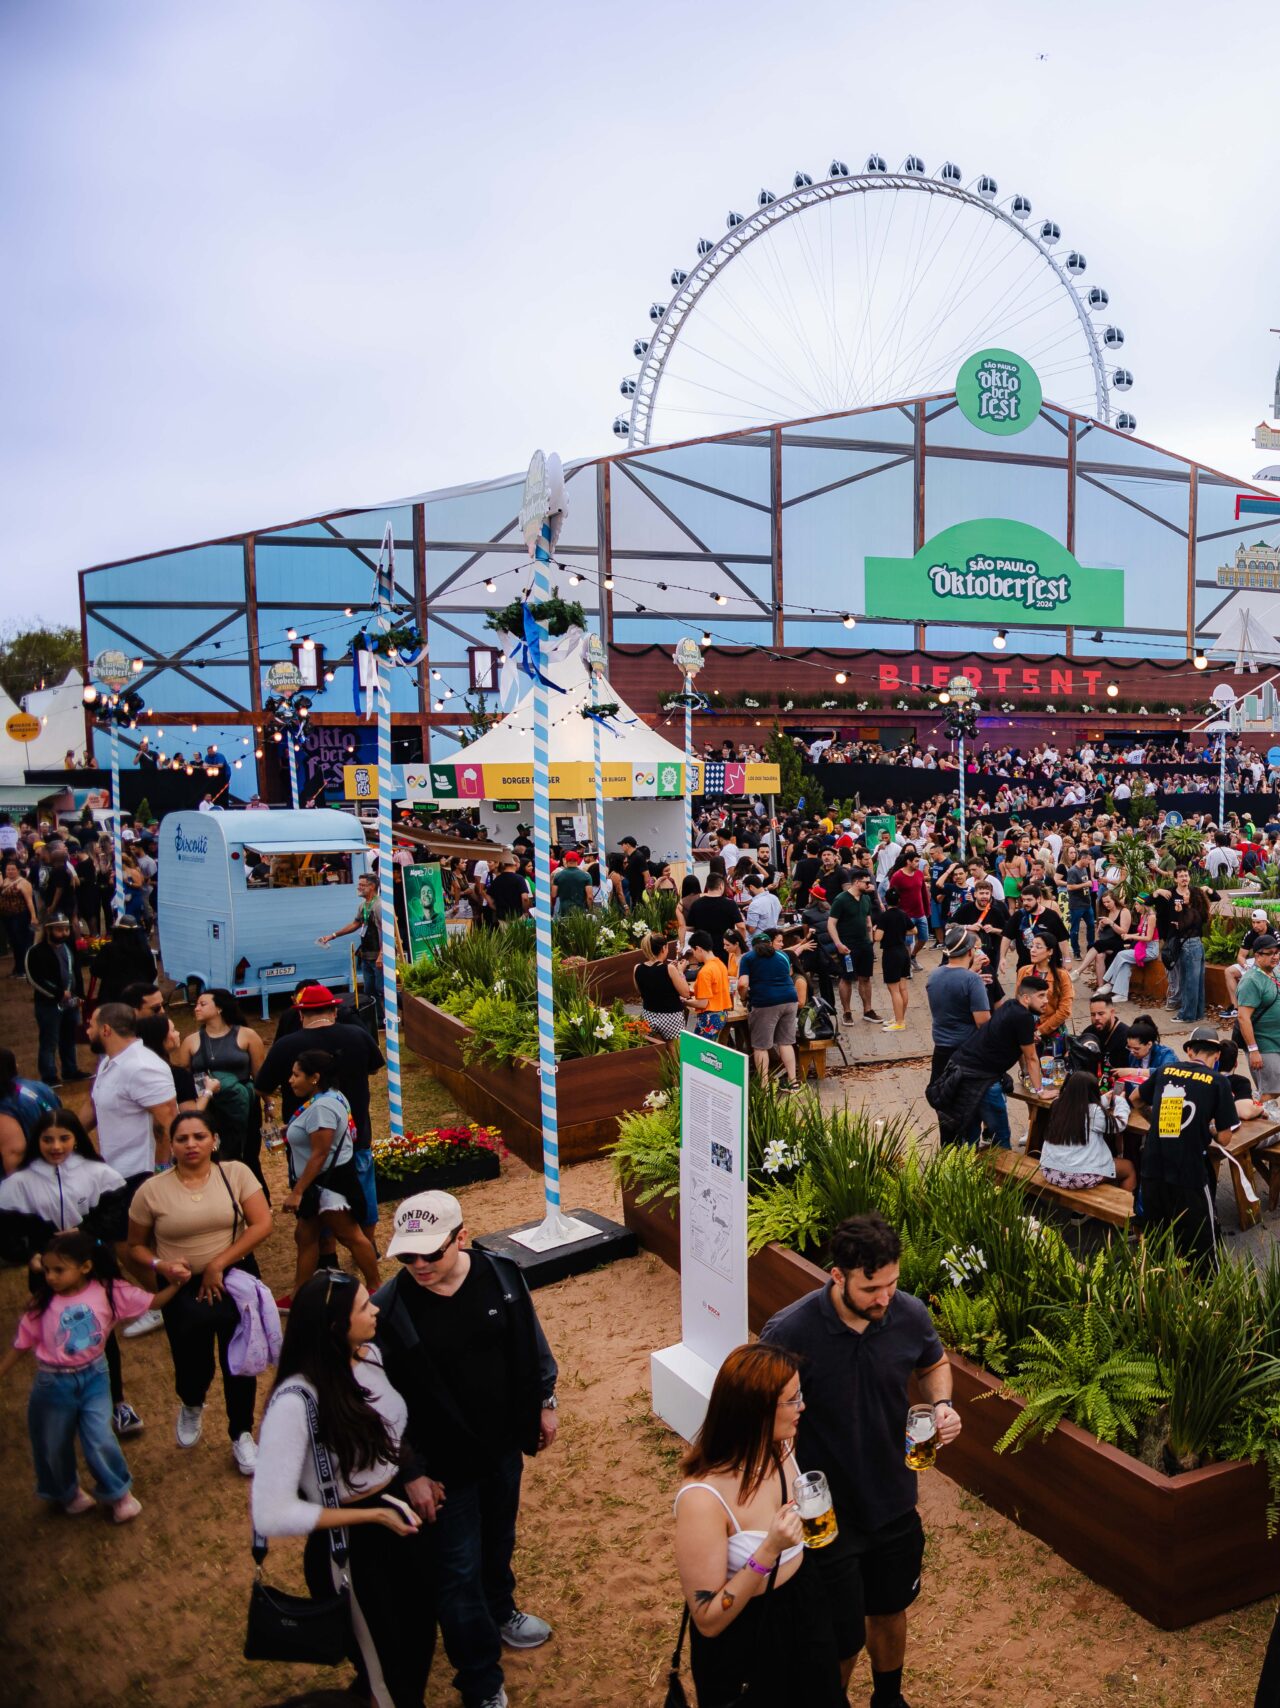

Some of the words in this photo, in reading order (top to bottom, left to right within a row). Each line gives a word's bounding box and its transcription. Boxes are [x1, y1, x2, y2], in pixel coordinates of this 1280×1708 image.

[984, 361, 997, 369] SÃO
[997, 363, 1017, 372] PAULO
[981, 392, 1018, 418] fest
[969, 558, 996, 571] SÃO
[996, 560, 1036, 574] PAULO
[929, 564, 1068, 606] Oktoberfest
[1036, 600, 1054, 608] 2024
[879, 664, 1102, 696] BIERTENT
[502, 776, 531, 785] BORGER
[1164, 1067, 1192, 1079] STAFF
[1192, 1071, 1213, 1084] BAR
[397, 1209, 439, 1227] LONDON
[316, 1443, 330, 1478] GUESS
